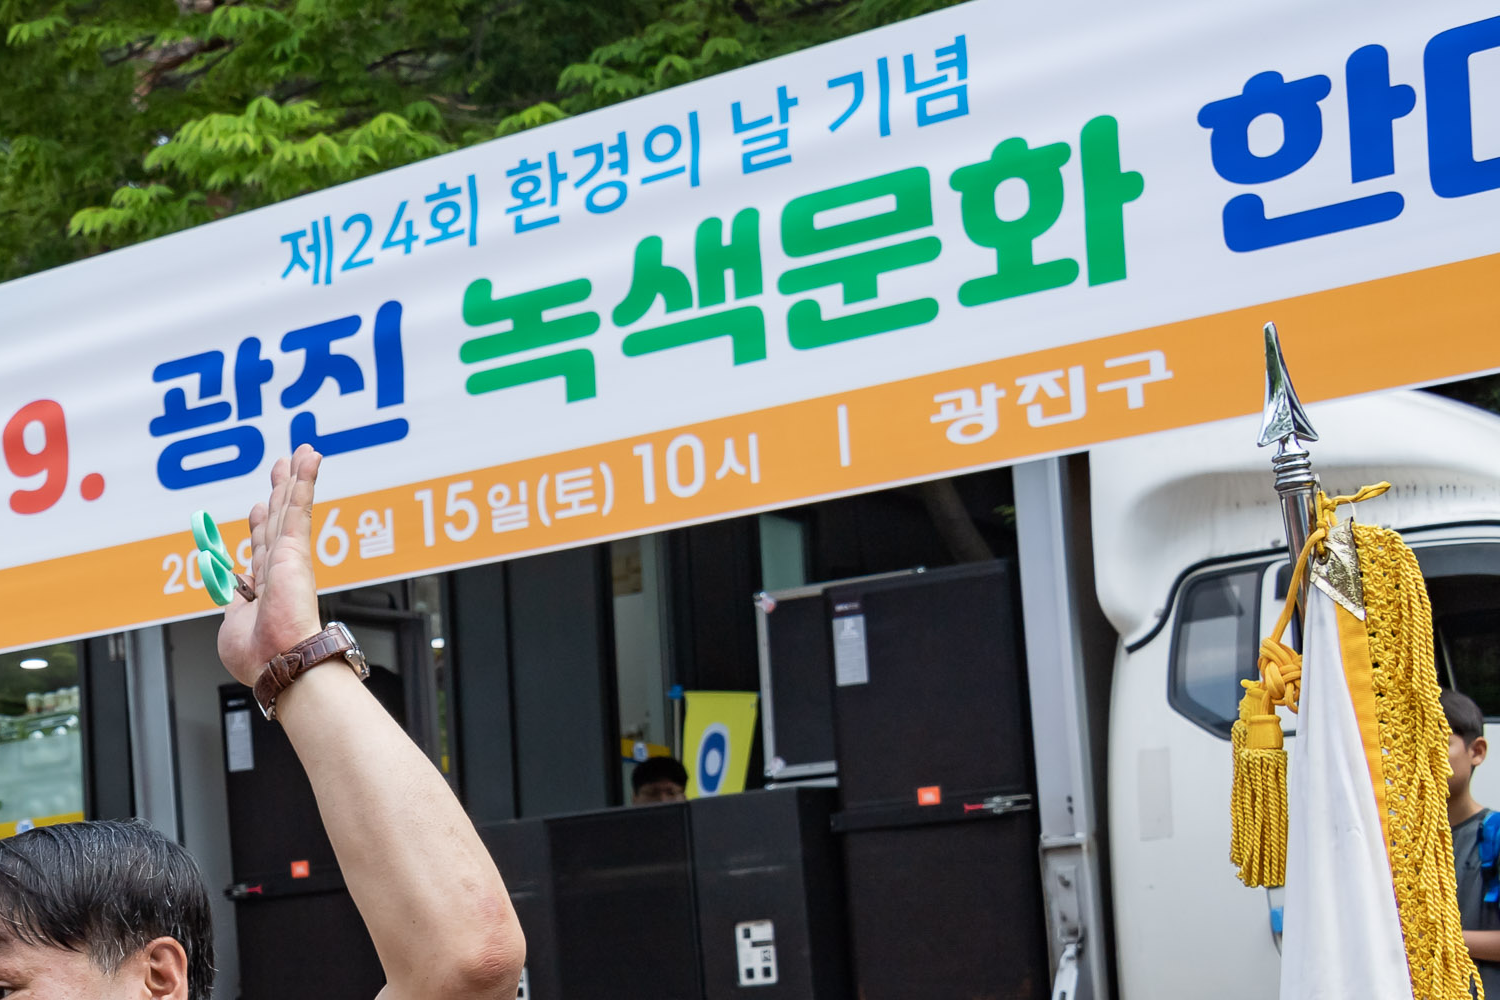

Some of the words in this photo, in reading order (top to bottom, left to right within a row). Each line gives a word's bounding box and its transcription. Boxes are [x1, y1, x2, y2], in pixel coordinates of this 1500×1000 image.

[280, 174, 478, 285] 제24회
[505, 110, 701, 234] 환경의
[730, 85, 799, 175] 날
[827, 34, 970, 138] 기념
[148, 299, 410, 491] 광진
[459, 115, 1144, 403] 녹색문화
[316, 508, 395, 567] 6월
[414, 462, 614, 547] 15일(토)
[633, 433, 760, 504] 10시
[929, 350, 1173, 444] 광진구
